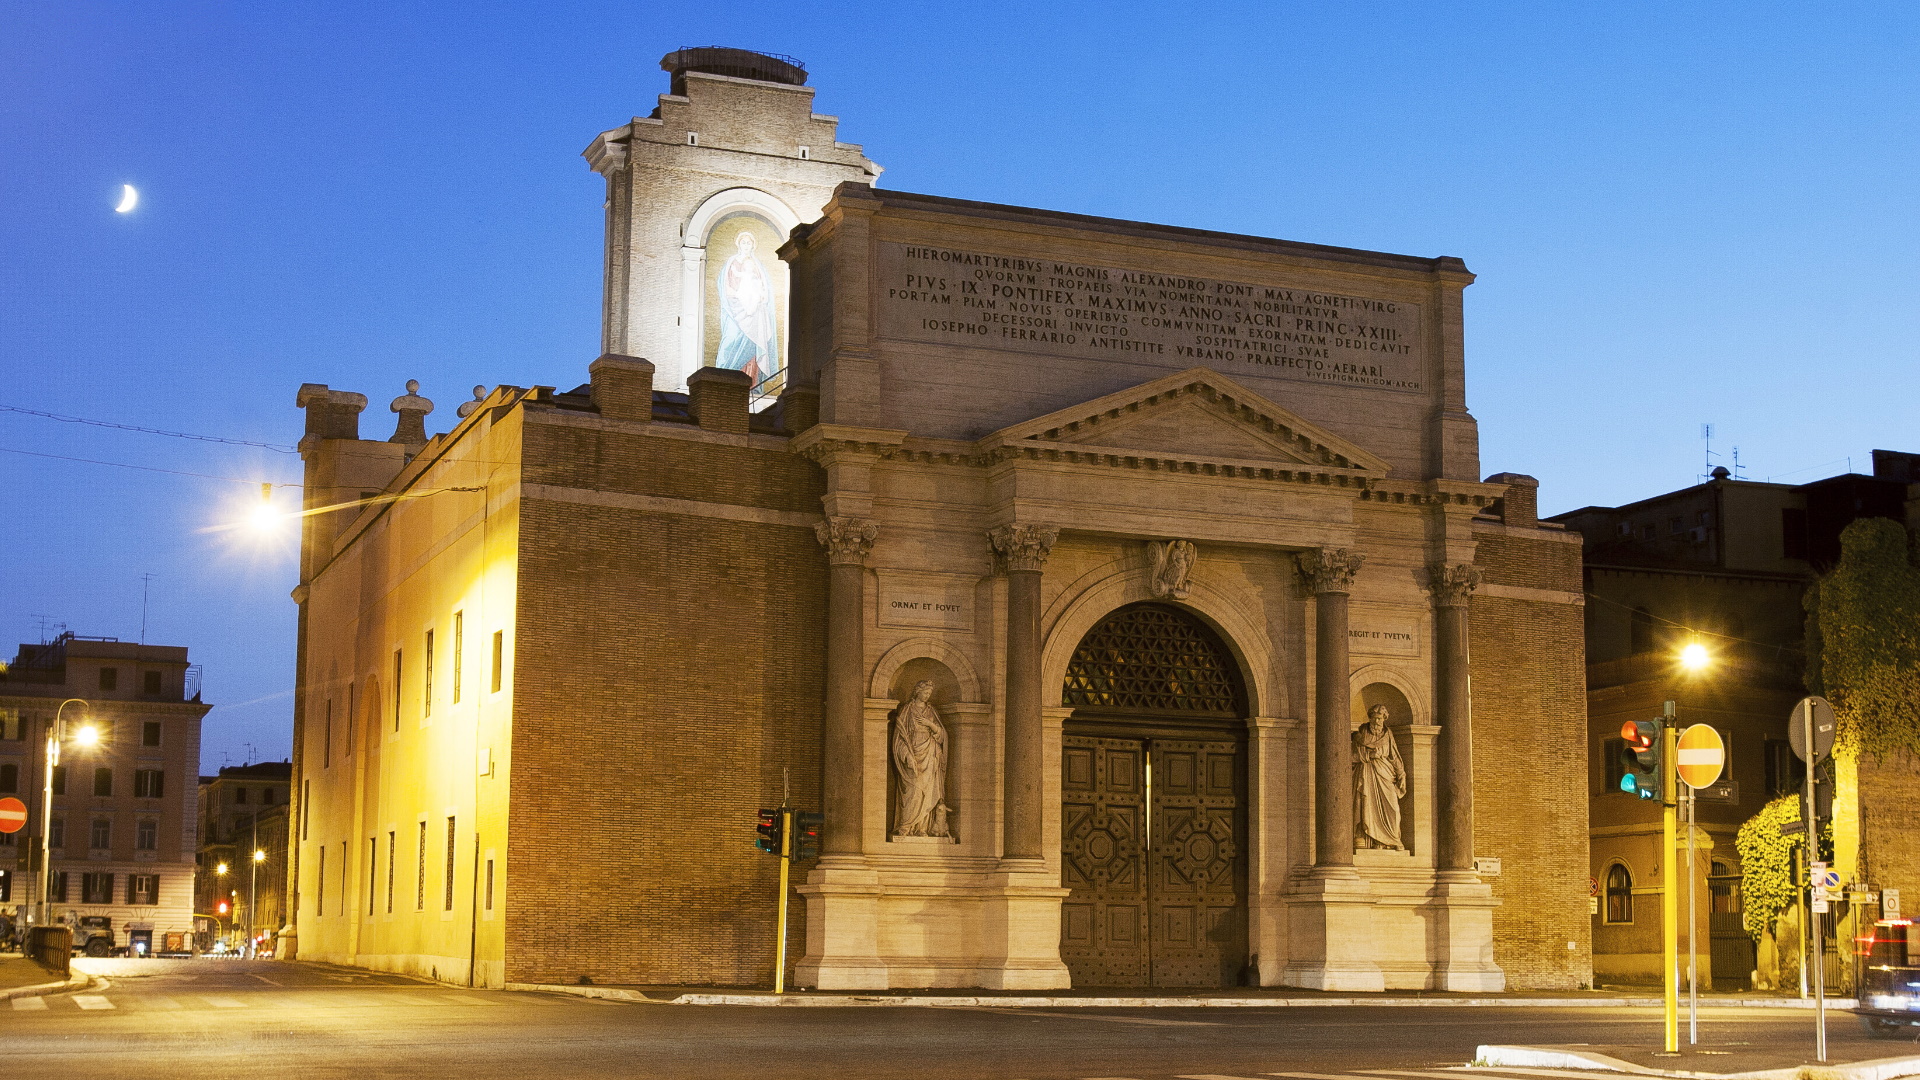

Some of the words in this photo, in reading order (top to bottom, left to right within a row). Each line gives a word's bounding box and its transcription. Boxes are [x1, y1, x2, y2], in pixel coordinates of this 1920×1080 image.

[907, 247, 1042, 272] HIEROMARTYRIBVS
[1054, 264, 1108, 280] MAGNIS
[1121, 273, 1205, 291] ALEXANDRO
[1217, 283, 1253, 296] PONT
[1265, 289, 1293, 301] MAX
[1304, 294, 1354, 308] AGNETI
[1362, 300, 1395, 313] VIRG
[974, 270, 1035, 284] QVORVM
[1049, 277, 1112, 293] TROPAEIS
[1124, 286, 1146, 297] VIA
[1160, 290, 1241, 308] NOMENTANA
[1254, 301, 1338, 319] NOBILITATVR
[890, 289, 950, 304] PORTAM
[964, 297, 995, 309] PIAM
[1010, 302, 1051, 315] NOVIS
[1065, 308, 1127, 323] OPERIBVS
[1141, 317, 1236, 335] COMMVNITAM
[1249, 328, 1326, 345] EXORNATAM
[1336, 338, 1410, 354] DEDICAVIT
[907, 274, 946, 290] PIVS
[962, 281, 978, 294] IX
[992, 284, 1074, 304] PONTIFEX
[1089, 295, 1166, 315] MAXIMVS
[1179, 306, 1222, 320] ANNO
[1235, 312, 1280, 328] SACRI
[1296, 318, 1347, 335] PRINC
[1358, 325, 1396, 341] XXIII
[923, 319, 988, 335] IOSEPHO
[1003, 327, 1076, 344] FERRARIO
[1090, 337, 1163, 354] ANTISTITE
[1176, 346, 1234, 361] VRBANO
[1248, 354, 1323, 370] PRAEFECTO
[1333, 363, 1382, 377] AERARI
[983, 312, 1056, 329] DECESSORI
[1070, 322, 1128, 336] INVICTO
[1196, 336, 1286, 353] SOSPITATRICI
[1298, 347, 1328, 358] SVAE
[891, 601, 918, 610] ORNAT
[922, 603, 932, 611] ET
[935, 603, 960, 612] FOVET
[1348, 630, 1369, 638] REGIT
[1372, 631, 1380, 639] ET
[1383, 632, 1411, 641] TVETVR
